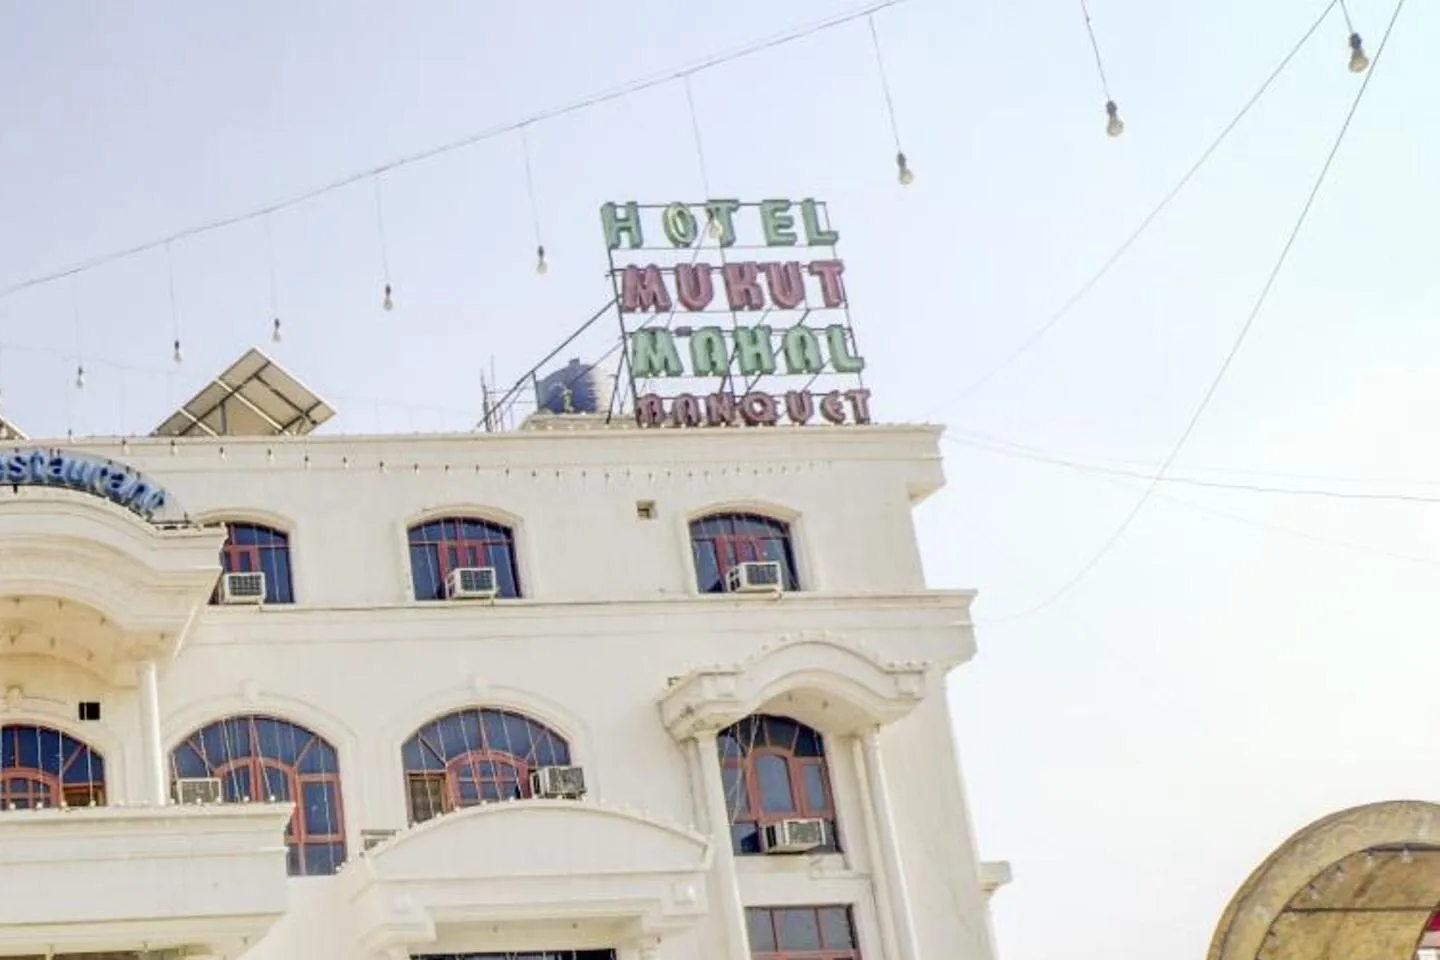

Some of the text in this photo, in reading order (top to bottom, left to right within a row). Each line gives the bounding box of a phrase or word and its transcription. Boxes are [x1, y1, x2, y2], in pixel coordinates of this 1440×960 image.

[600, 198, 839, 249] HOTEL
[621, 260, 845, 313] MUKUT
[630, 324, 865, 377] MAHAL
[635, 388, 871, 429] BANQUET
